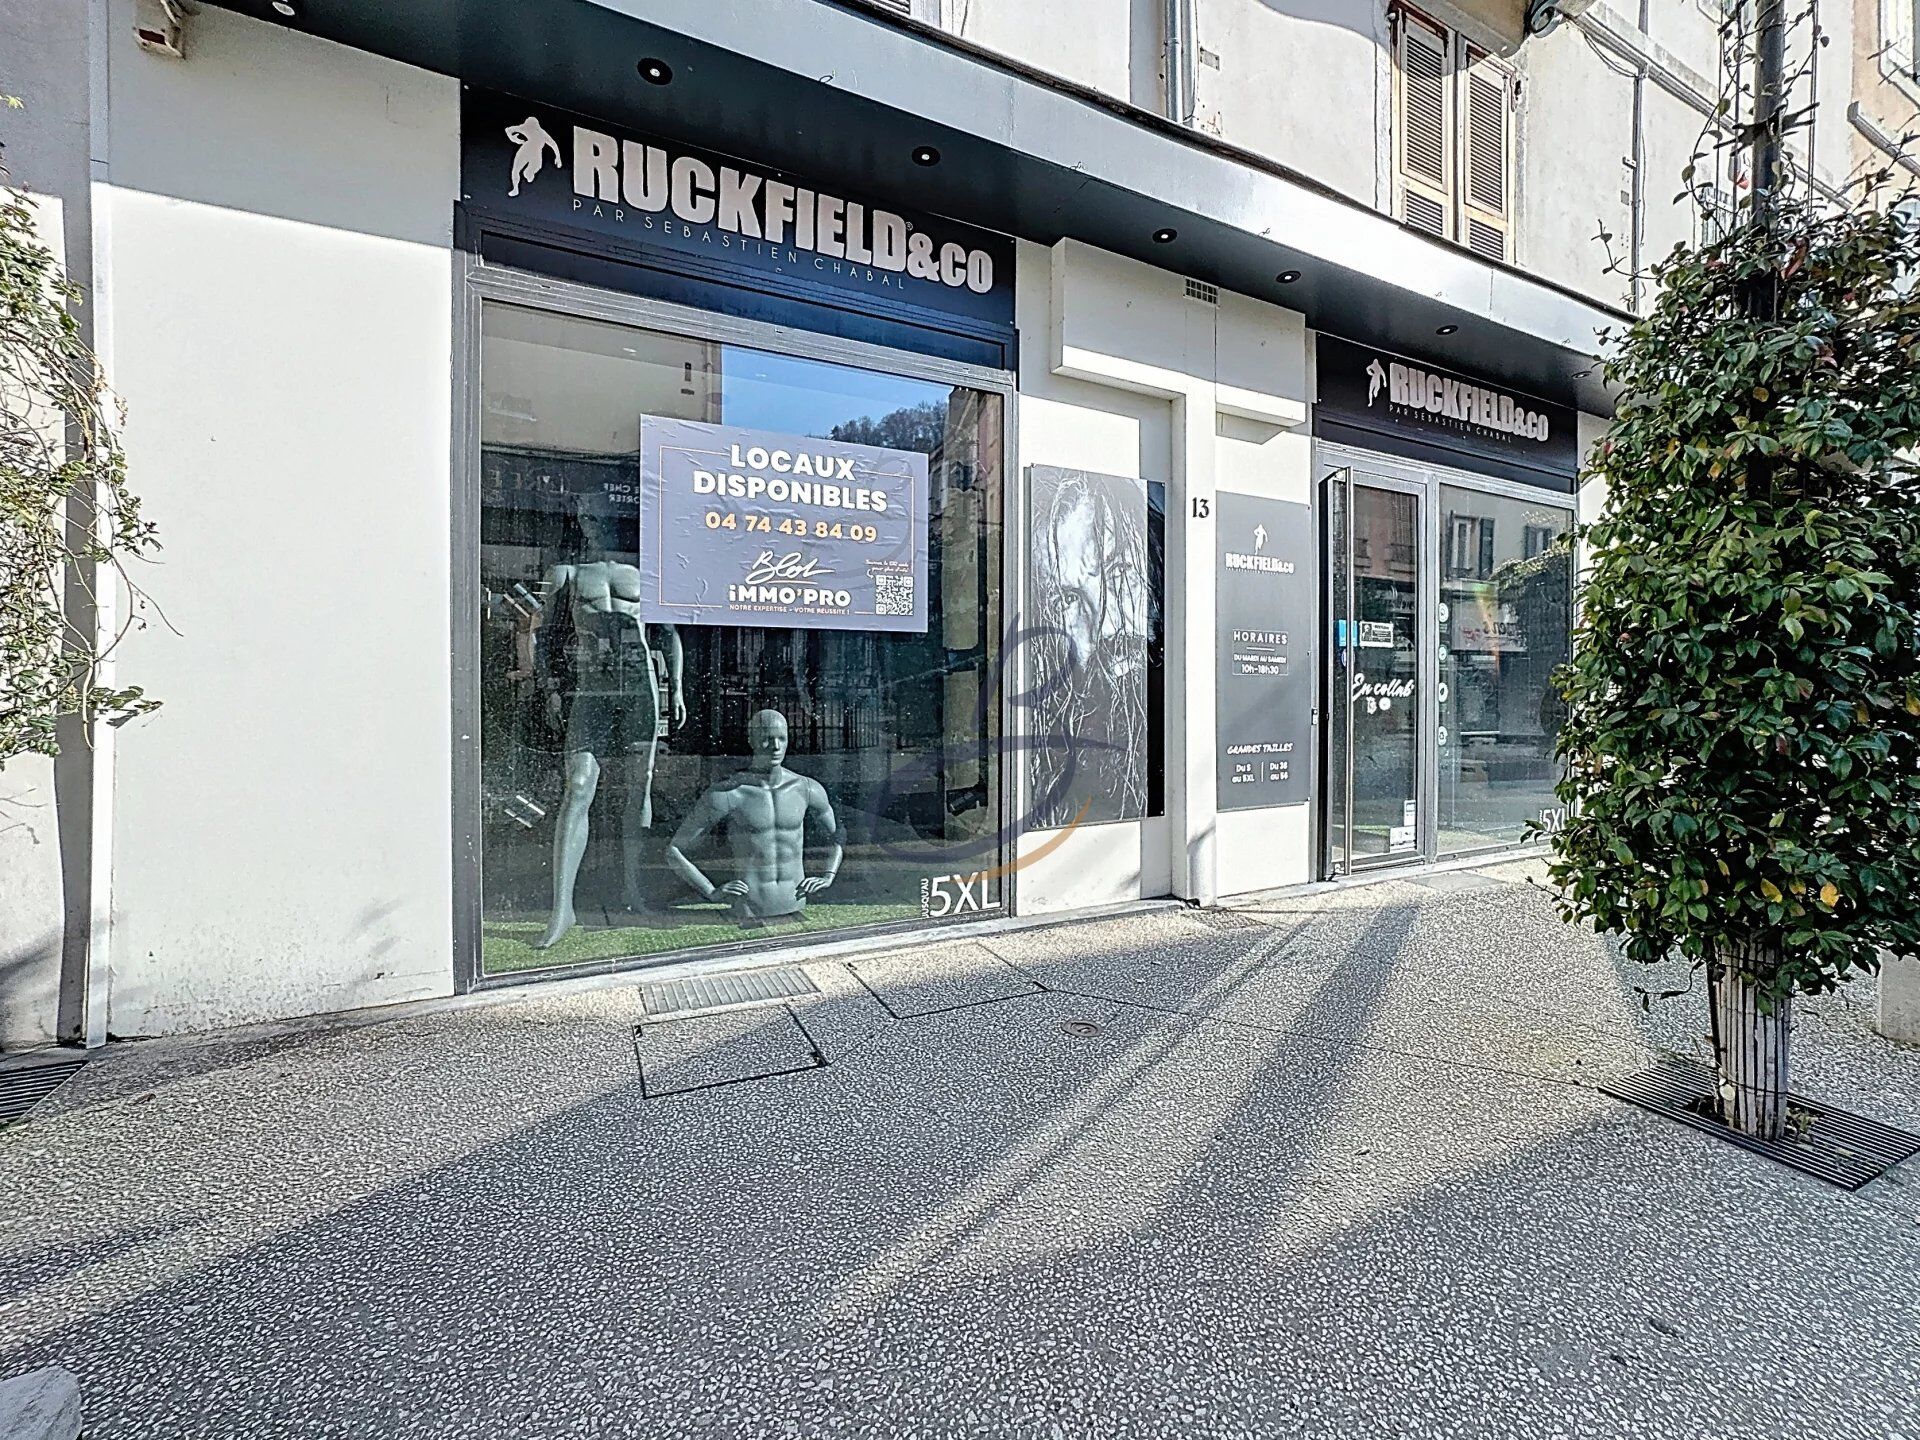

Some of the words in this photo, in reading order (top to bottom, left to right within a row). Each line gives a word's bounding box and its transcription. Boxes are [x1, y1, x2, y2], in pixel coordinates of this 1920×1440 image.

[573, 199, 624, 222] PAR
[644, 216, 797, 264] SEBASTIEN
[814, 257, 904, 290] CHABAL
[1389, 404, 1408, 416] PAR
[1414, 410, 1471, 432] SEBASTIEN
[1476, 427, 1511, 443] CHABAL
[730, 444, 856, 481] LOCAUX
[693, 470, 888, 512] DISPONIBLES
[1192, 497, 1210, 518] 13
[705, 512, 737, 530] 04
[745, 515, 772, 533] 74
[778, 518, 807, 536] 43
[815, 522, 842, 539] 84
[850, 525, 877, 542] 09
[753, 605, 788, 613] EXPERTISE
[1233, 630, 1287, 645] HORAIRES
[1227, 744, 1262, 755] GRANDES
[1262, 742, 1294, 753] TAILLES
[929, 870, 1001, 917] 5XL
